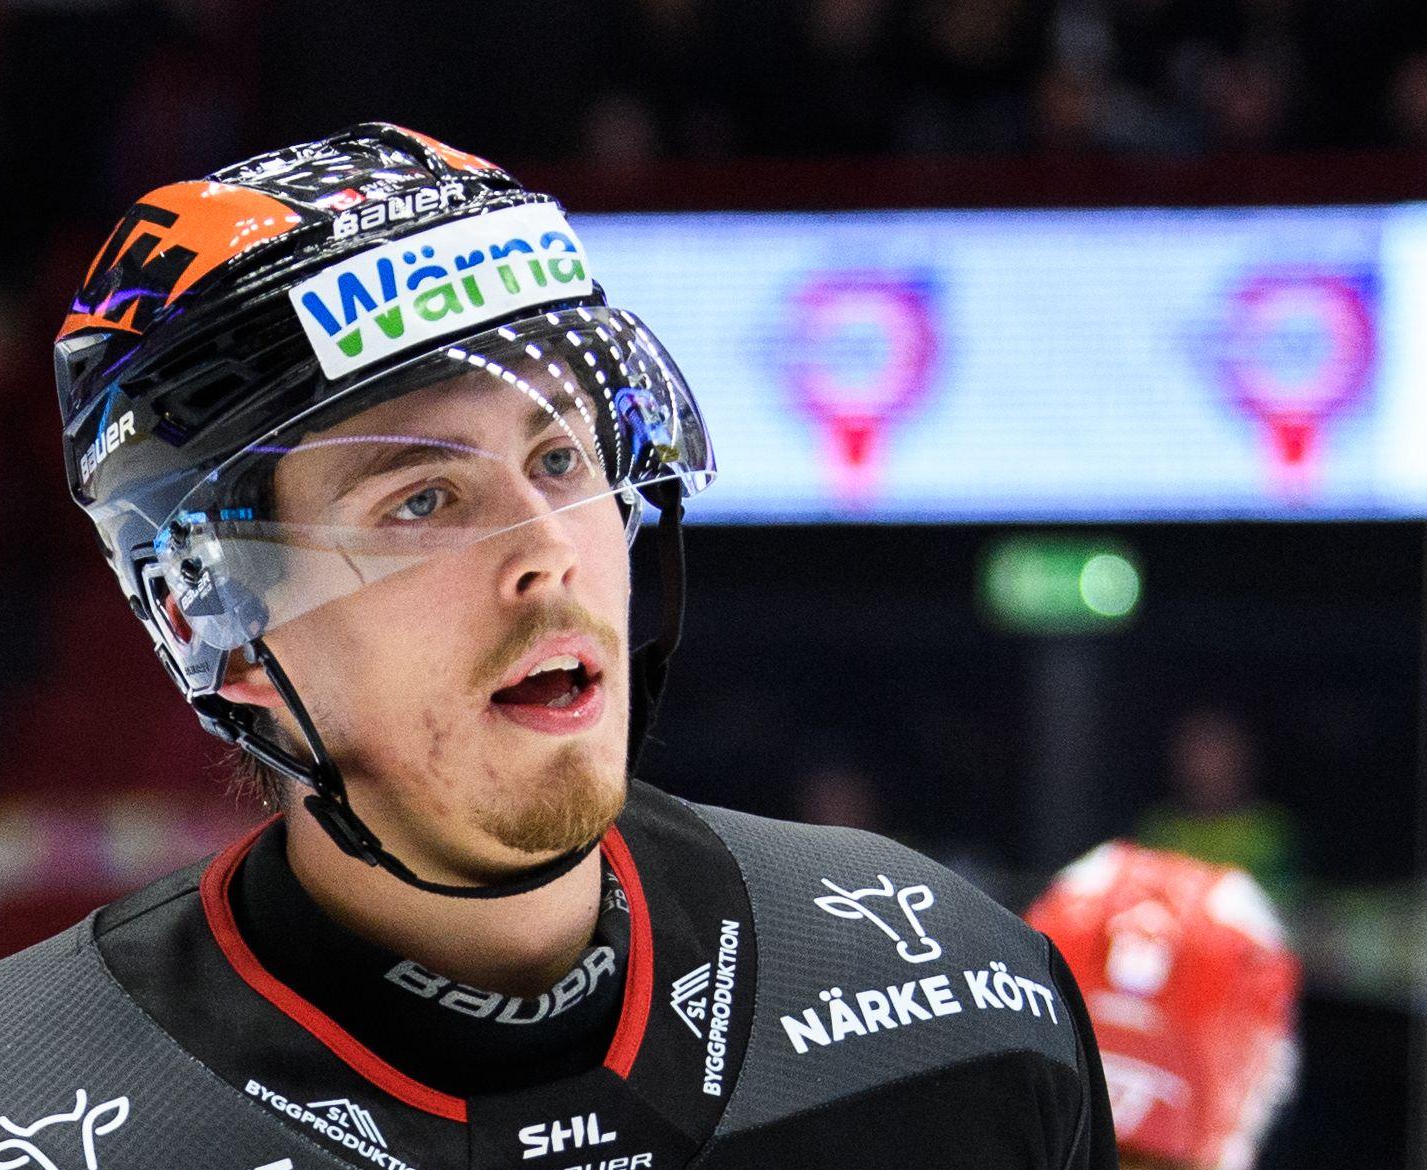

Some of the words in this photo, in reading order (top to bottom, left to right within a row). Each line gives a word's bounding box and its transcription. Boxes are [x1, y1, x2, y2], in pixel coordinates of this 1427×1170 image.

[300, 230, 586, 358] Wärna
[687, 997, 707, 1020] SL
[703, 920, 740, 1096] BYGGPRODUKTION
[780, 974, 962, 1054] NÄRKE
[964, 961, 1061, 1025] KÖTT
[326, 1106, 350, 1127] SL
[518, 1112, 617, 1159] SHL
